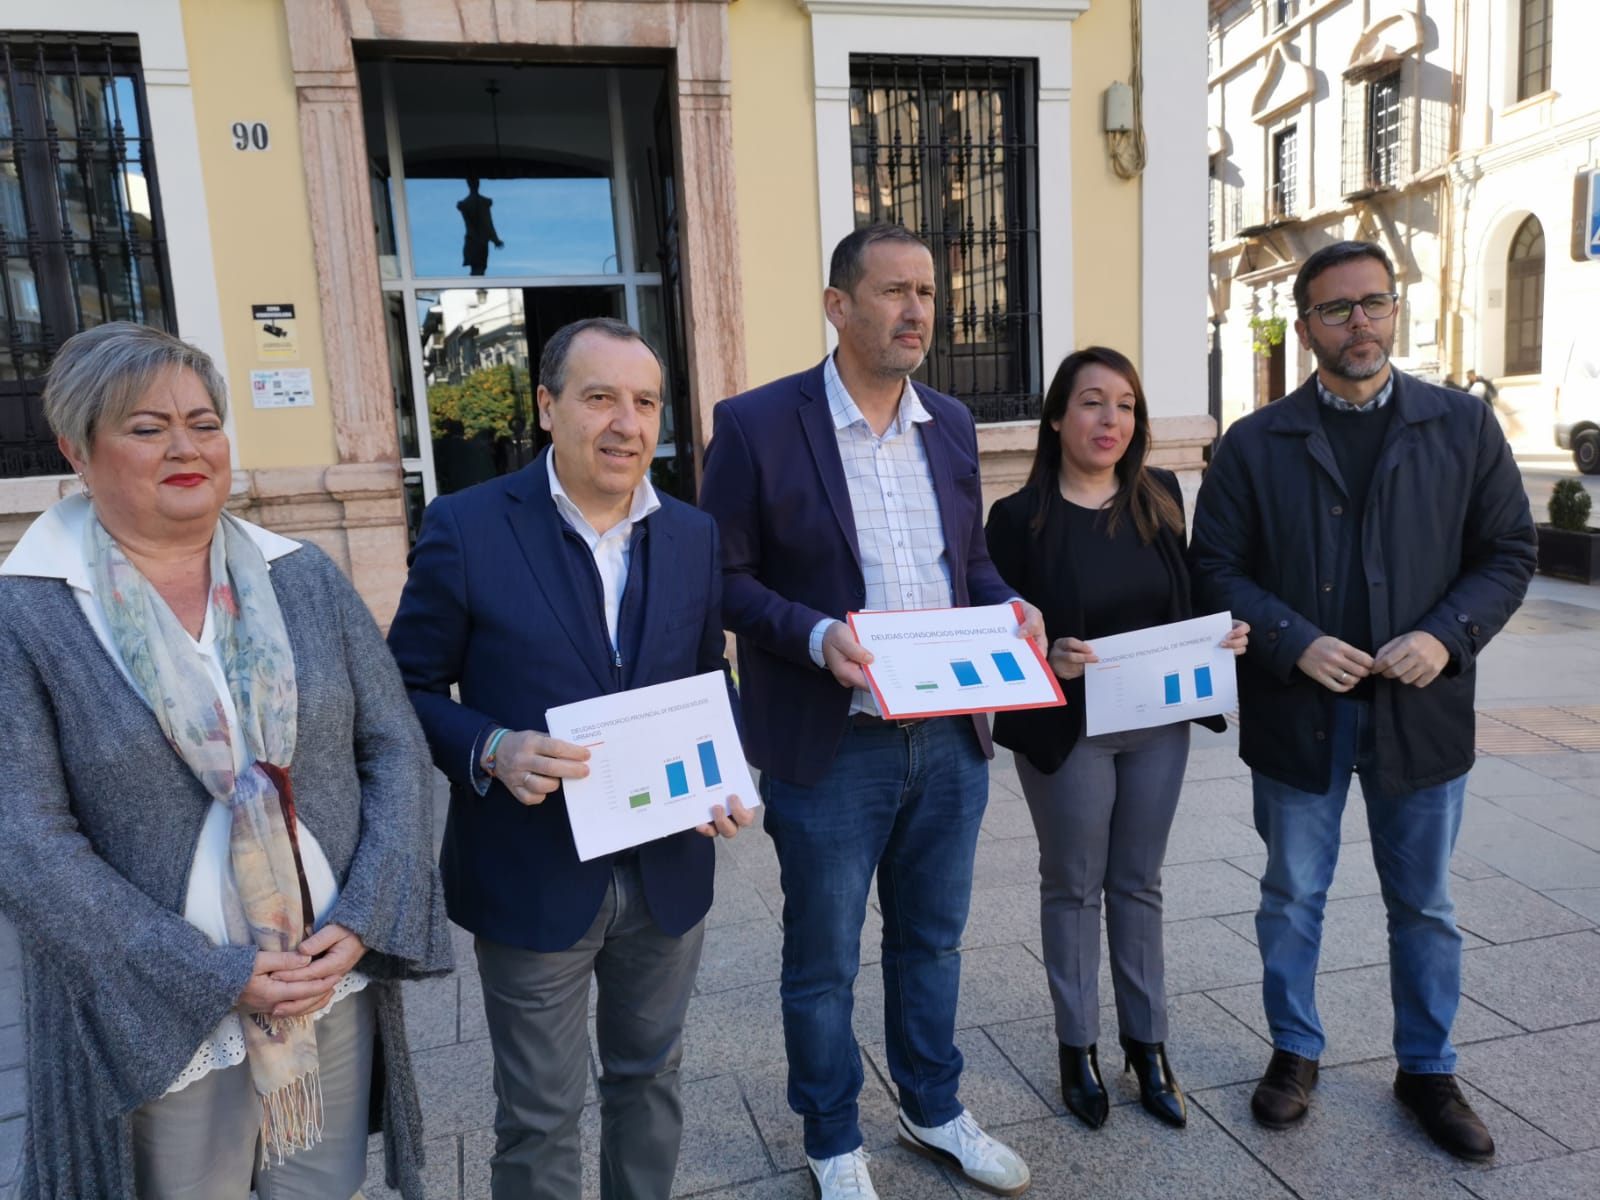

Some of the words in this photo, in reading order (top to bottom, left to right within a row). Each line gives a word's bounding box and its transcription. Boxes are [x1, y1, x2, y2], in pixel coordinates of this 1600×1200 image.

[232, 122, 268, 150] 90
[870, 632, 902, 641] DEUDAS
[903, 630, 954, 639] CONSORCIOS
[955, 626, 1007, 636] PROVINCIALES
[1136, 645, 1169, 657] PROVINCIAL
